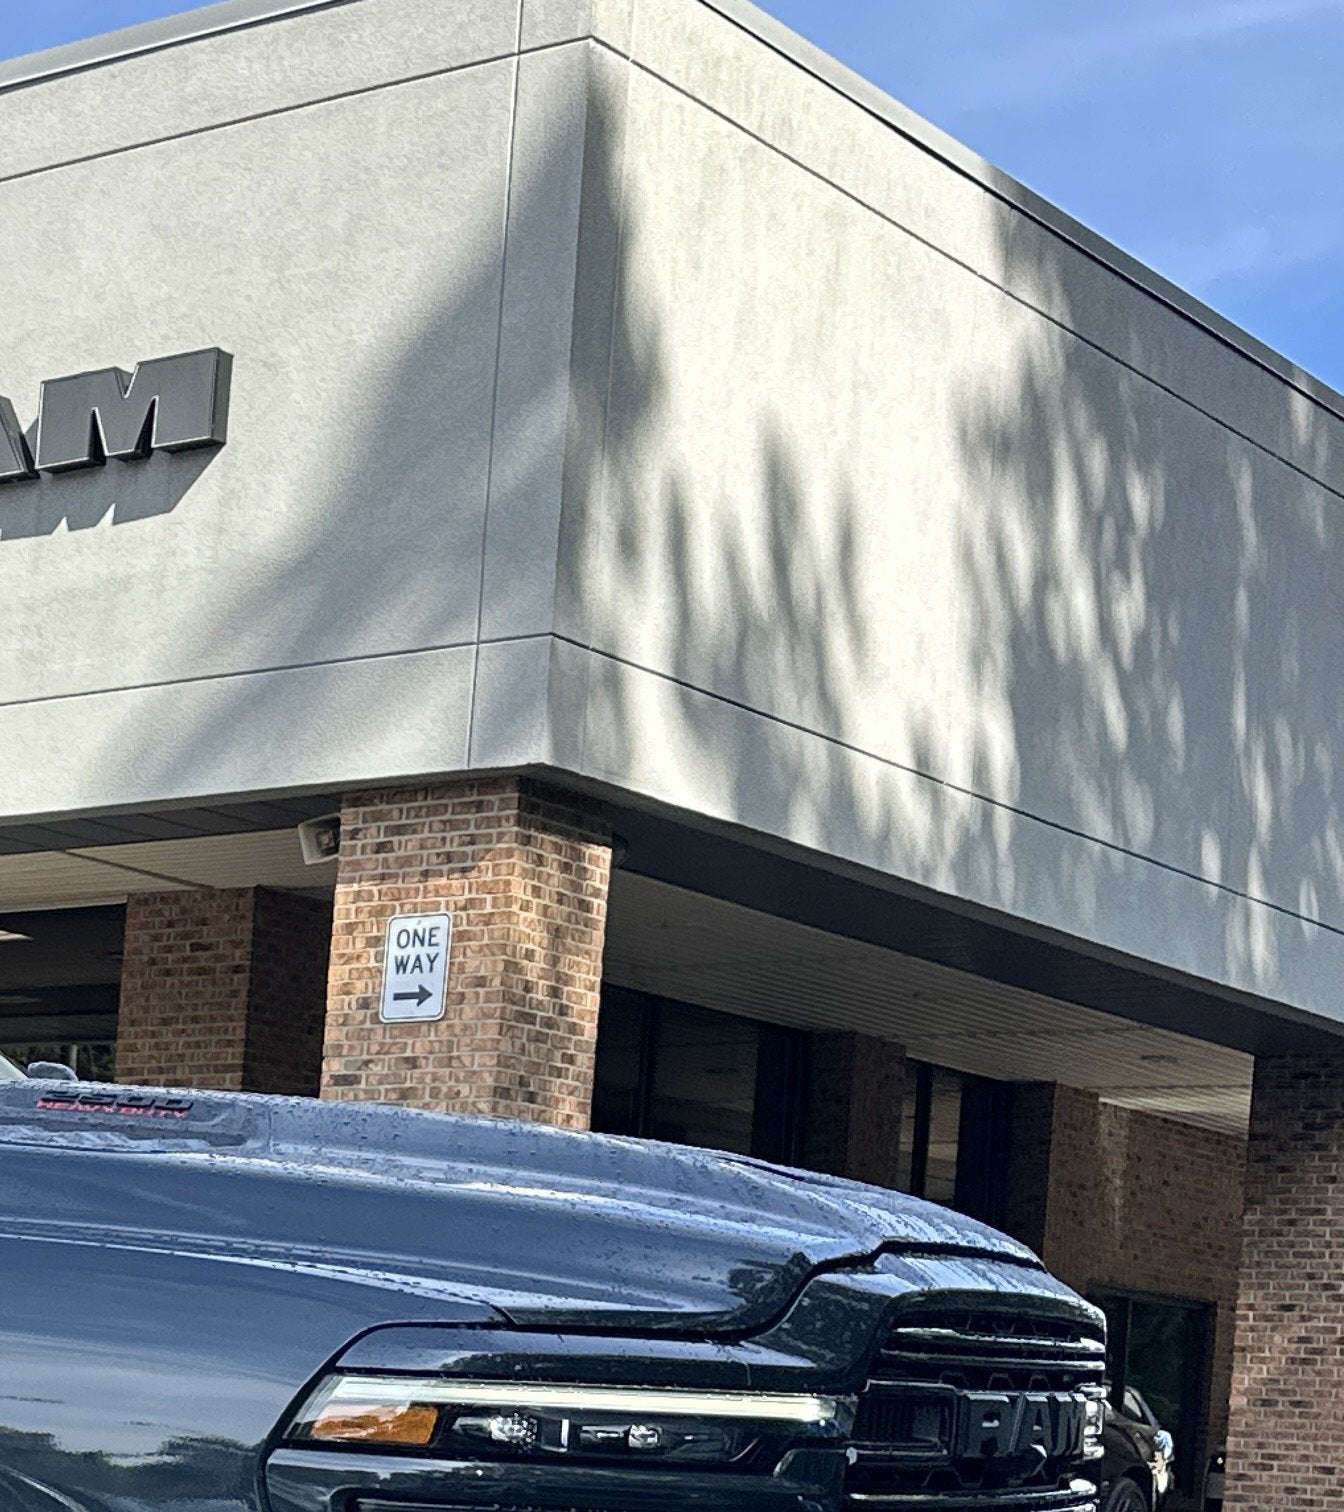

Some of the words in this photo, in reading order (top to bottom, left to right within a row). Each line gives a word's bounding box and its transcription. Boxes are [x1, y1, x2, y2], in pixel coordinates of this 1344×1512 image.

[396, 927, 440, 949] ONE
[394, 951, 440, 975] WAY
[962, 1390, 1088, 1458] RAM
